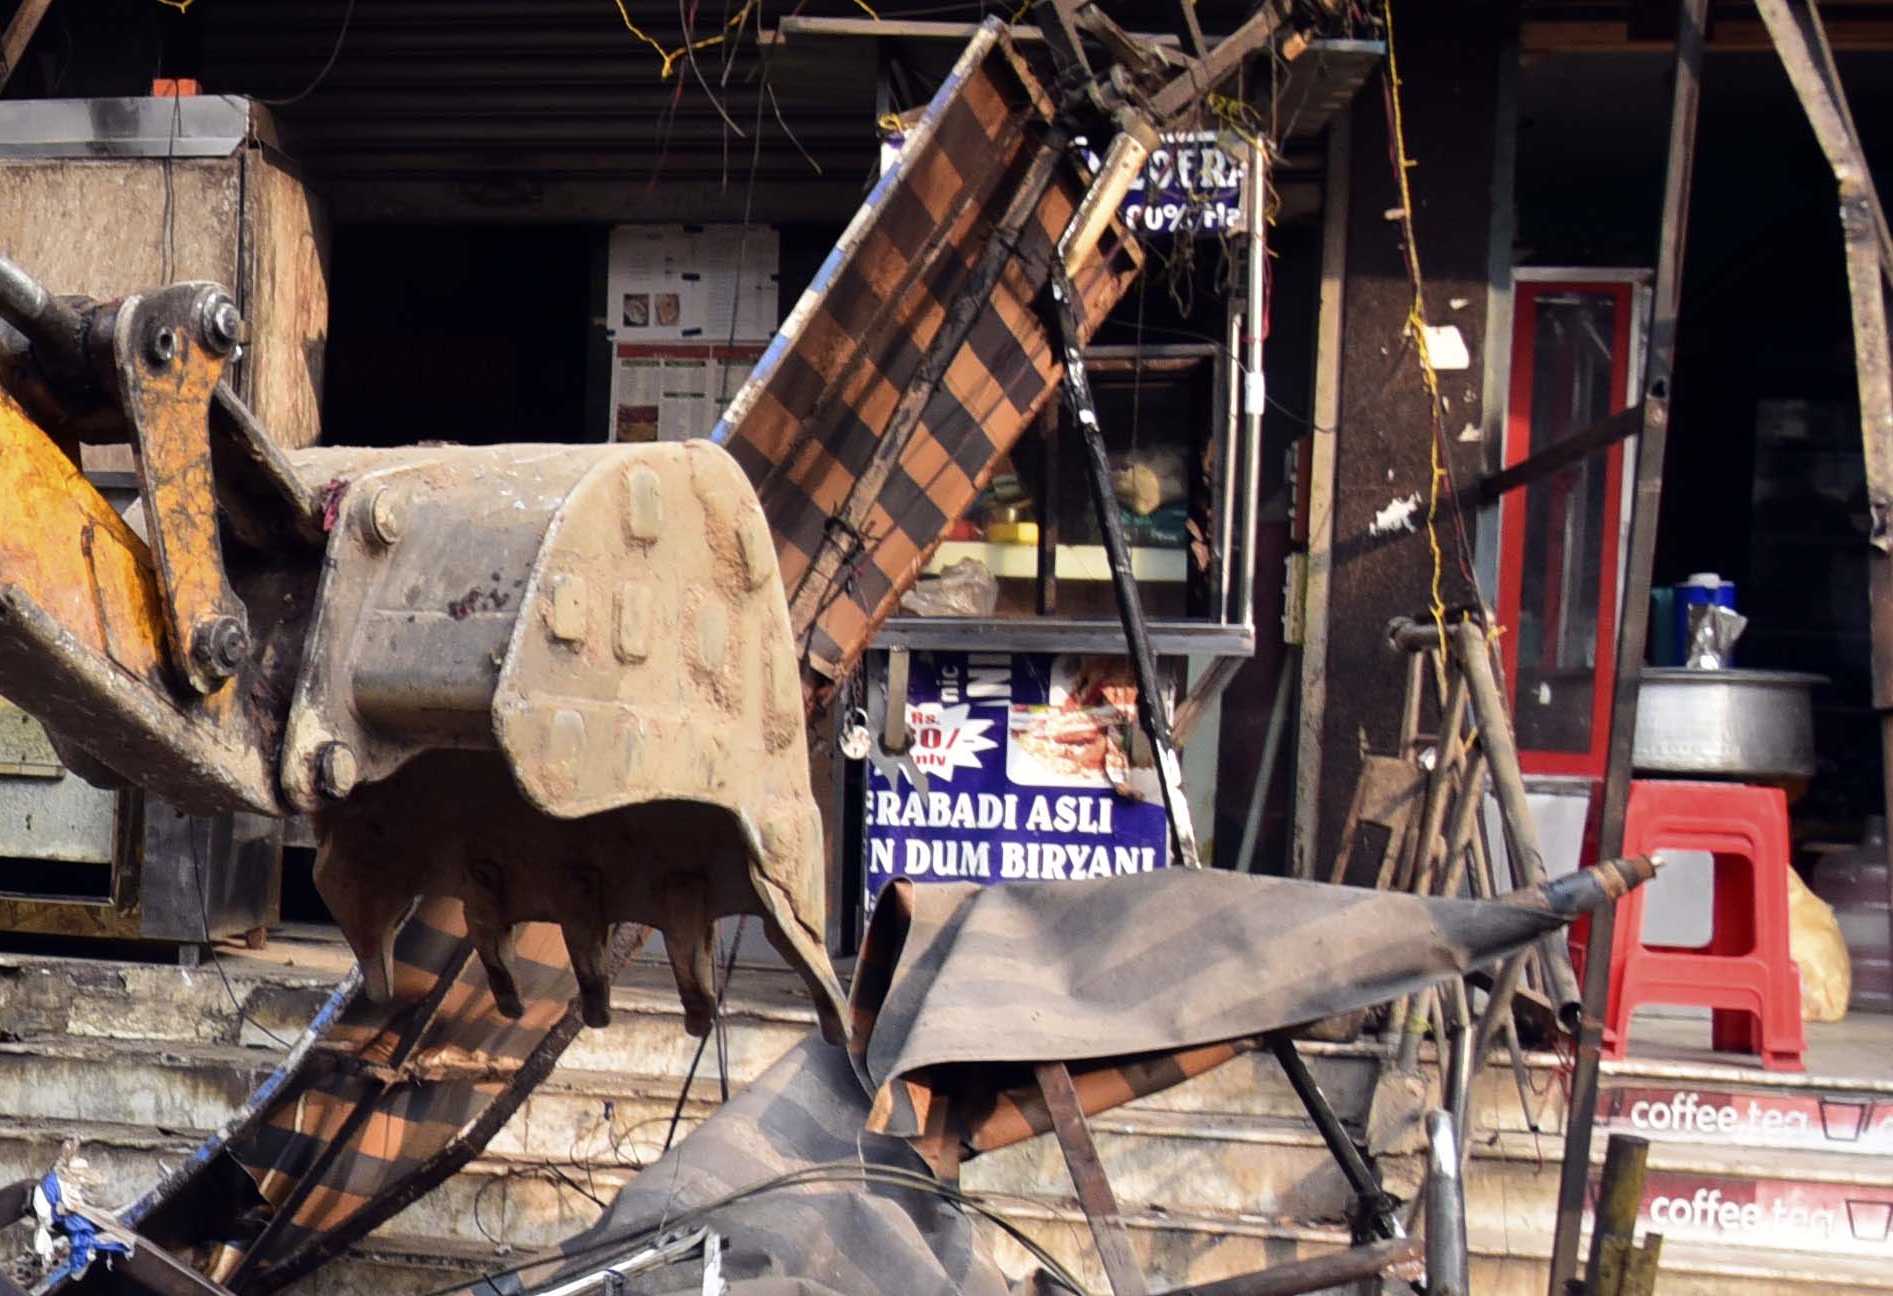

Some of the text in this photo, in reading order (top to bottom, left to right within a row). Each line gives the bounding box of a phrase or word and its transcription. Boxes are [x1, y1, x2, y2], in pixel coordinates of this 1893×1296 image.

[1025, 794, 1114, 835] ASLI
[904, 838, 991, 878] DUM
[999, 841, 1156, 881] BIRYANI
[1630, 1091, 1810, 1134] coffee tea
[1650, 1187, 1762, 1230] coffee
